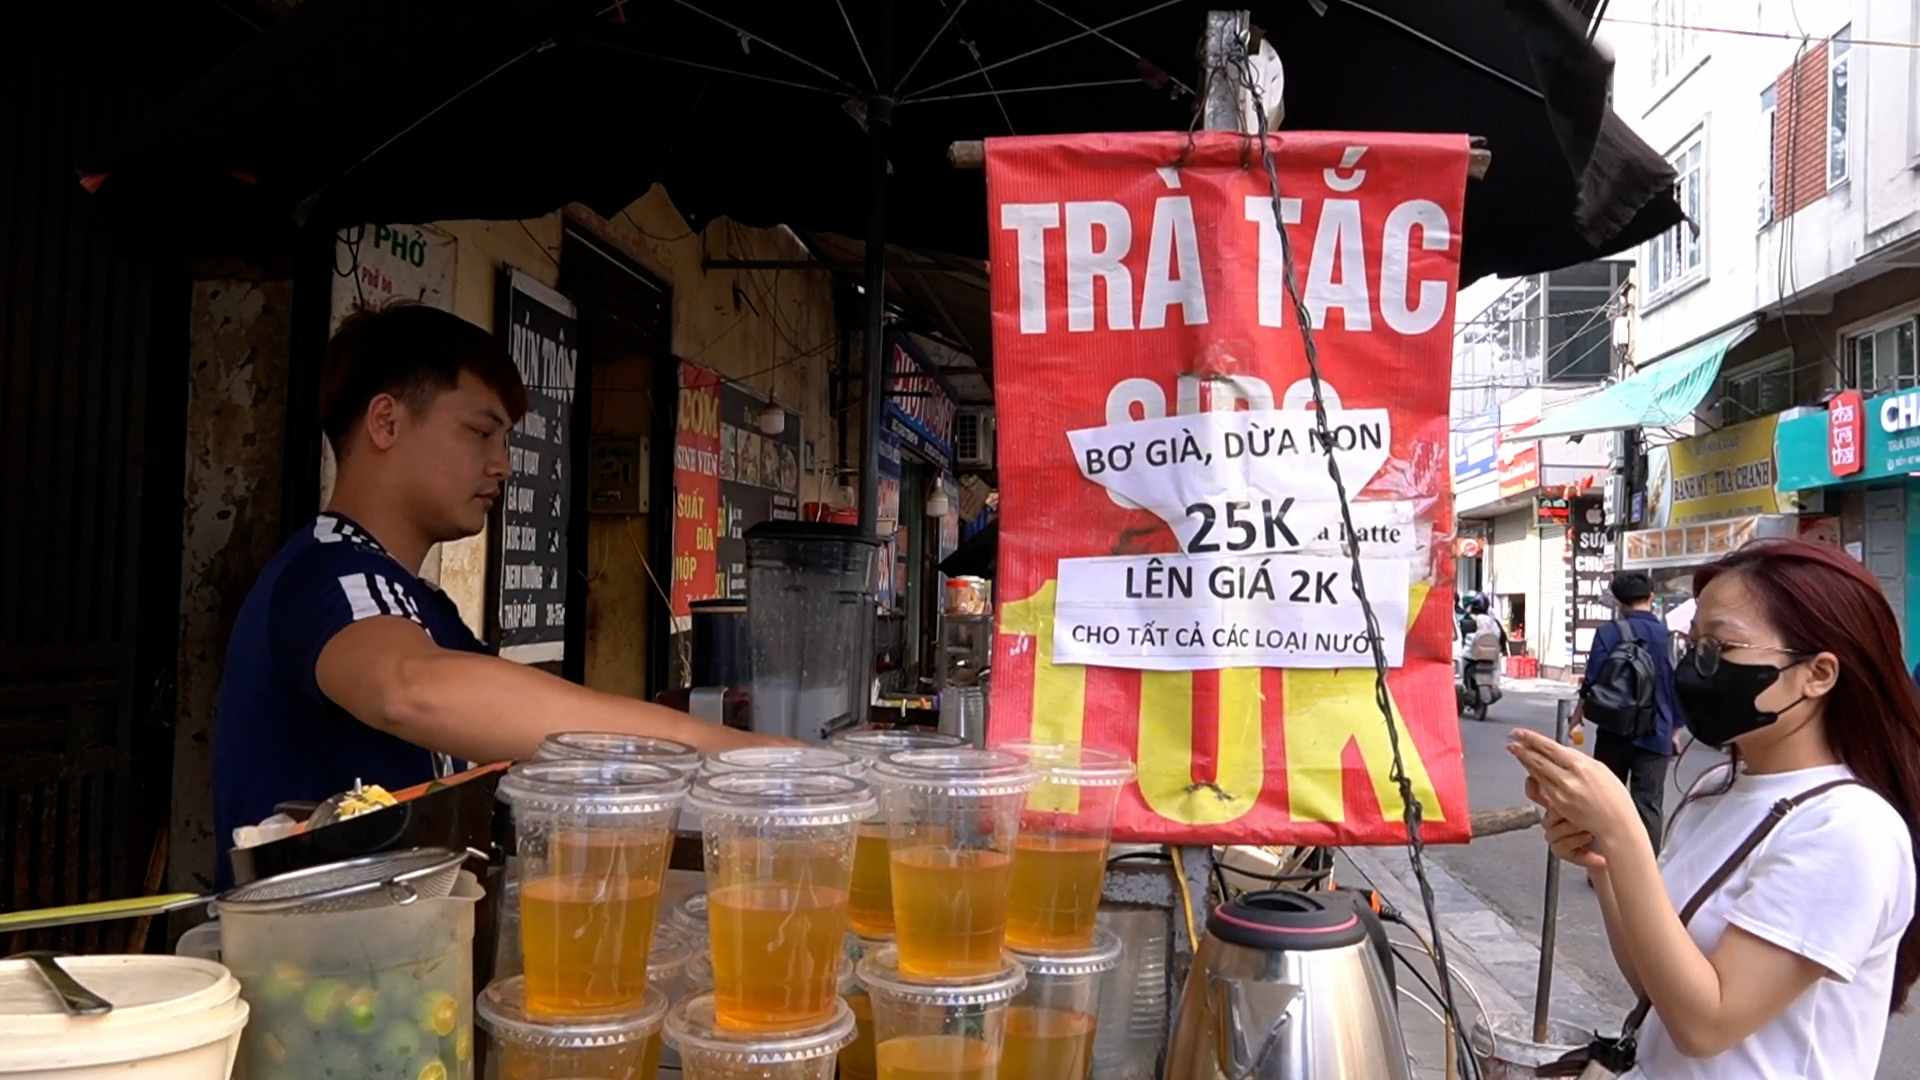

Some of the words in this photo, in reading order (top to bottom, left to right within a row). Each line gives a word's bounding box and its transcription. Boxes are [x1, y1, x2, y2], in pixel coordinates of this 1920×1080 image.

[1001, 168, 1209, 335] TRÀ
[1244, 146, 1450, 335] TẮC
[680, 388, 720, 439] CƠM
[1881, 393, 1920, 432] CH
[1085, 442, 1135, 475] BƠ
[1145, 428, 1212, 466] GIÀ,
[1225, 422, 1298, 459] DỪA
[1309, 422, 1383, 456] NON
[677, 487, 705, 520] SUẤT
[1184, 497, 1300, 555] 25K
[1125, 557, 1193, 600] LÊN
[1208, 558, 1276, 602] GIÁ
[1288, 568, 1339, 605] 2K
[1072, 624, 1120, 646] CHO
[1127, 619, 1170, 647] TẤT
[1175, 620, 1205, 648] CẢ
[1212, 620, 1250, 648] CÁC
[1255, 628, 1308, 655] LOẠI
[1315, 624, 1384, 655] NƯỚ
